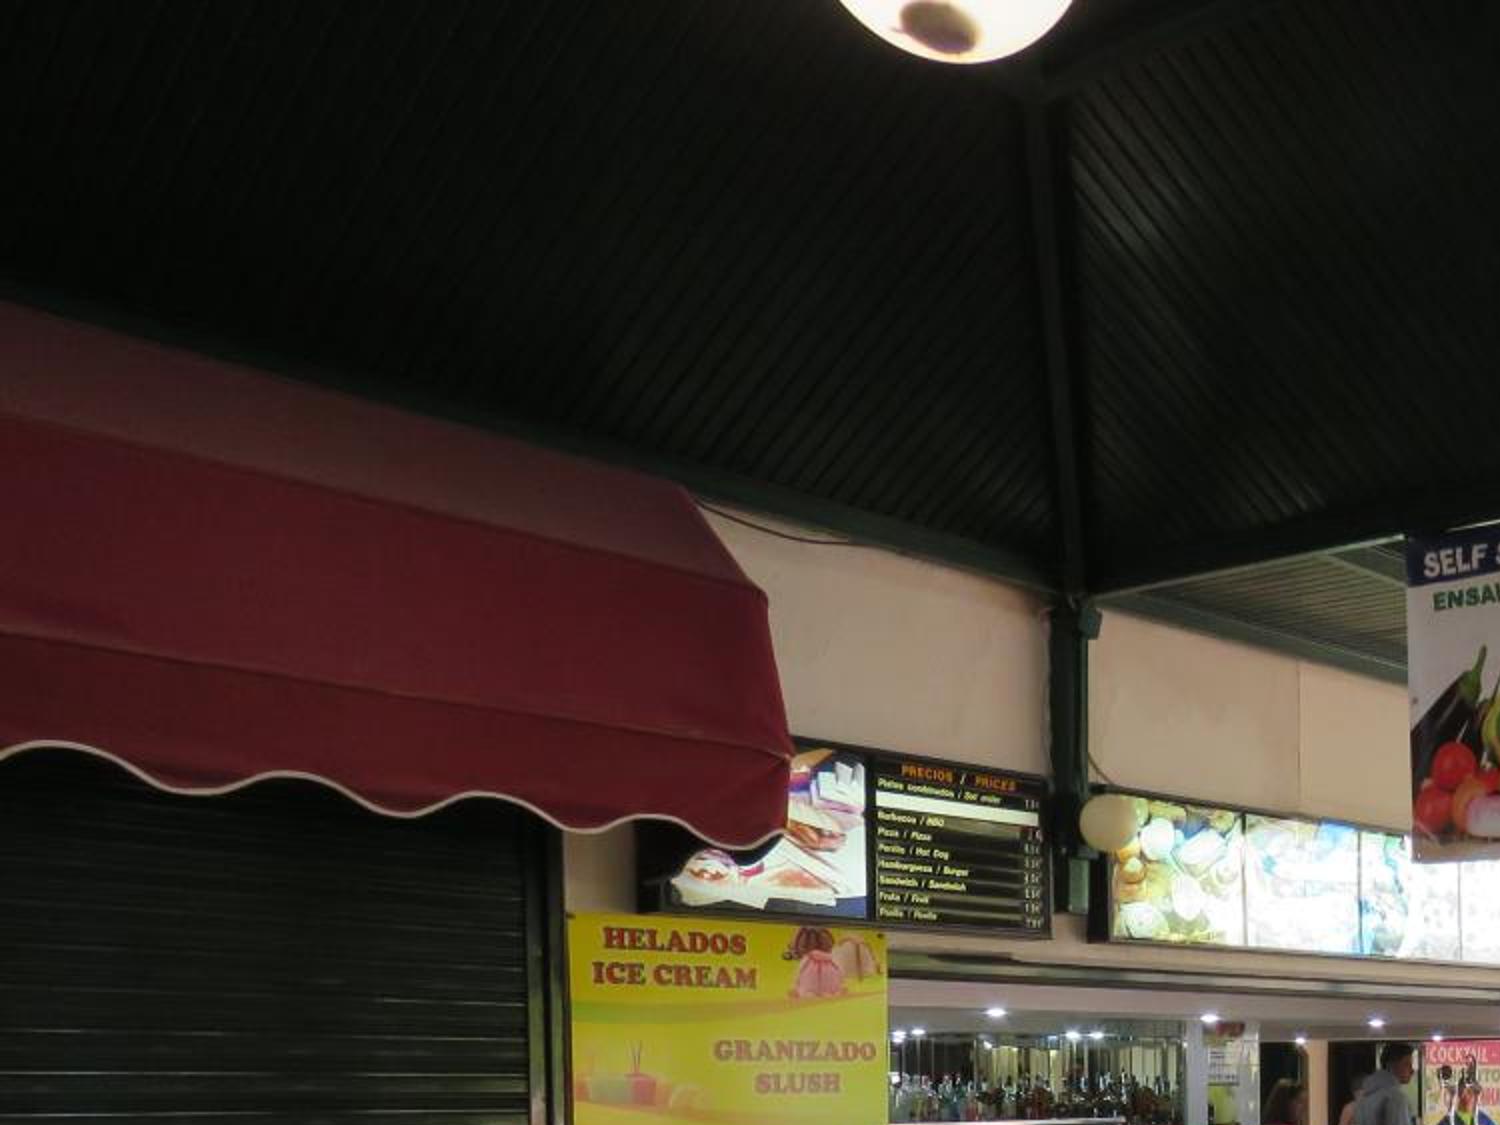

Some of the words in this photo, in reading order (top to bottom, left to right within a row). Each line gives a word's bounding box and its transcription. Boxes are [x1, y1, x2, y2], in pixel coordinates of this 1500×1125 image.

[1423, 543, 1488, 578] SELF
[603, 926, 747, 955] HELADOS
[592, 961, 647, 986] ICE
[653, 962, 757, 990] CREAM
[714, 1039, 877, 1061] GRANIZADO
[755, 1072, 841, 1095] SLUSH
